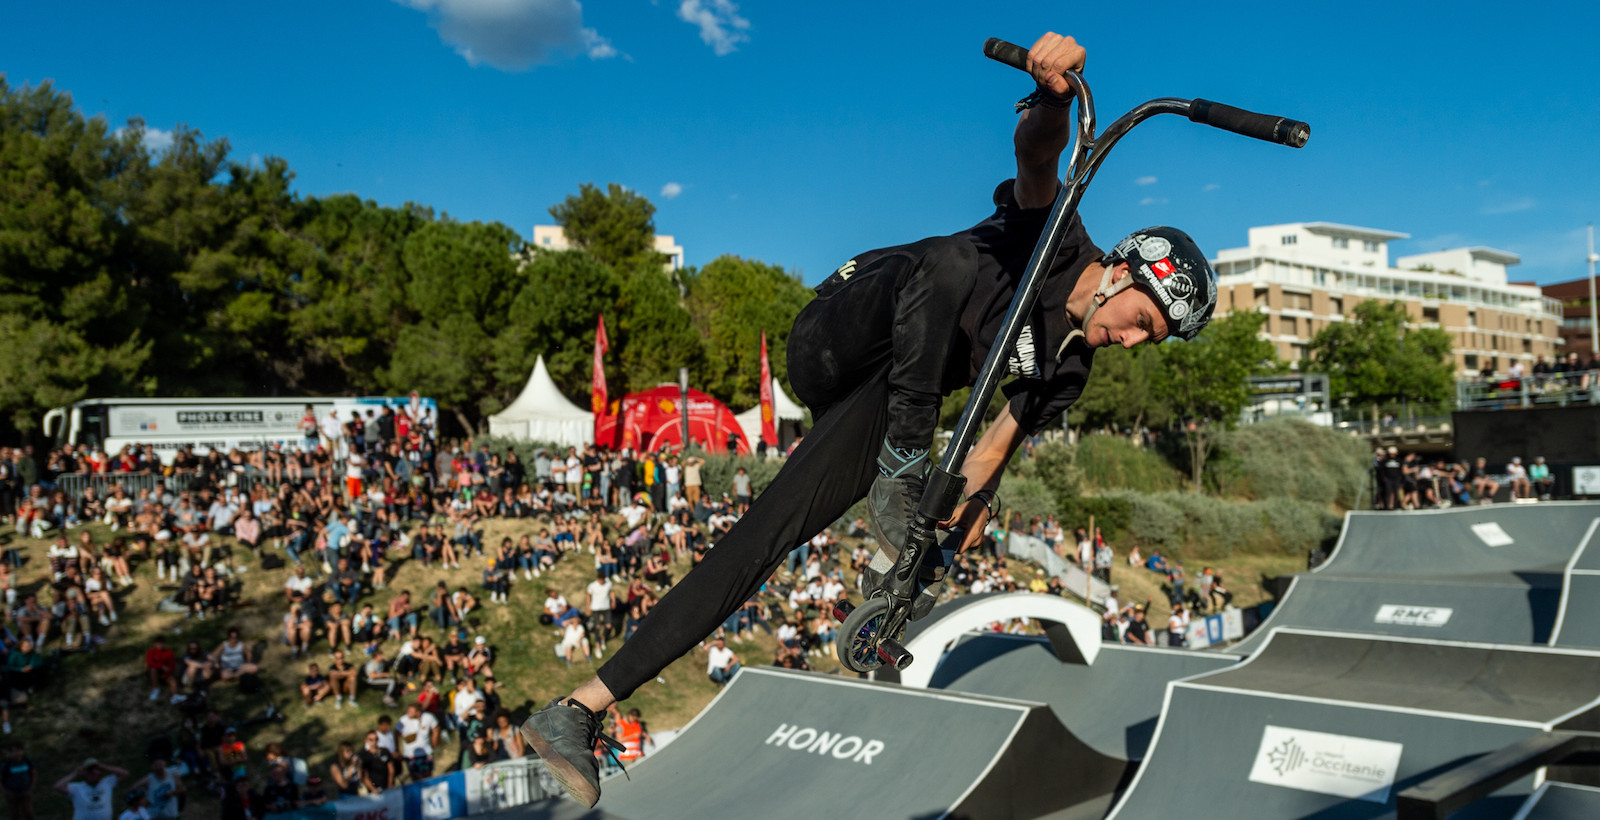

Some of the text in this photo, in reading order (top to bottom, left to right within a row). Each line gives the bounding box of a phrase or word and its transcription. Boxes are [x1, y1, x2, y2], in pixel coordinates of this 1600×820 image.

[1139, 263, 1173, 306] UNSPONSORED
[178, 411, 227, 423] PHOTO
[1392, 608, 1437, 621] RMC
[765, 723, 885, 765] HONOR
[1312, 757, 1386, 779] Occitanie
